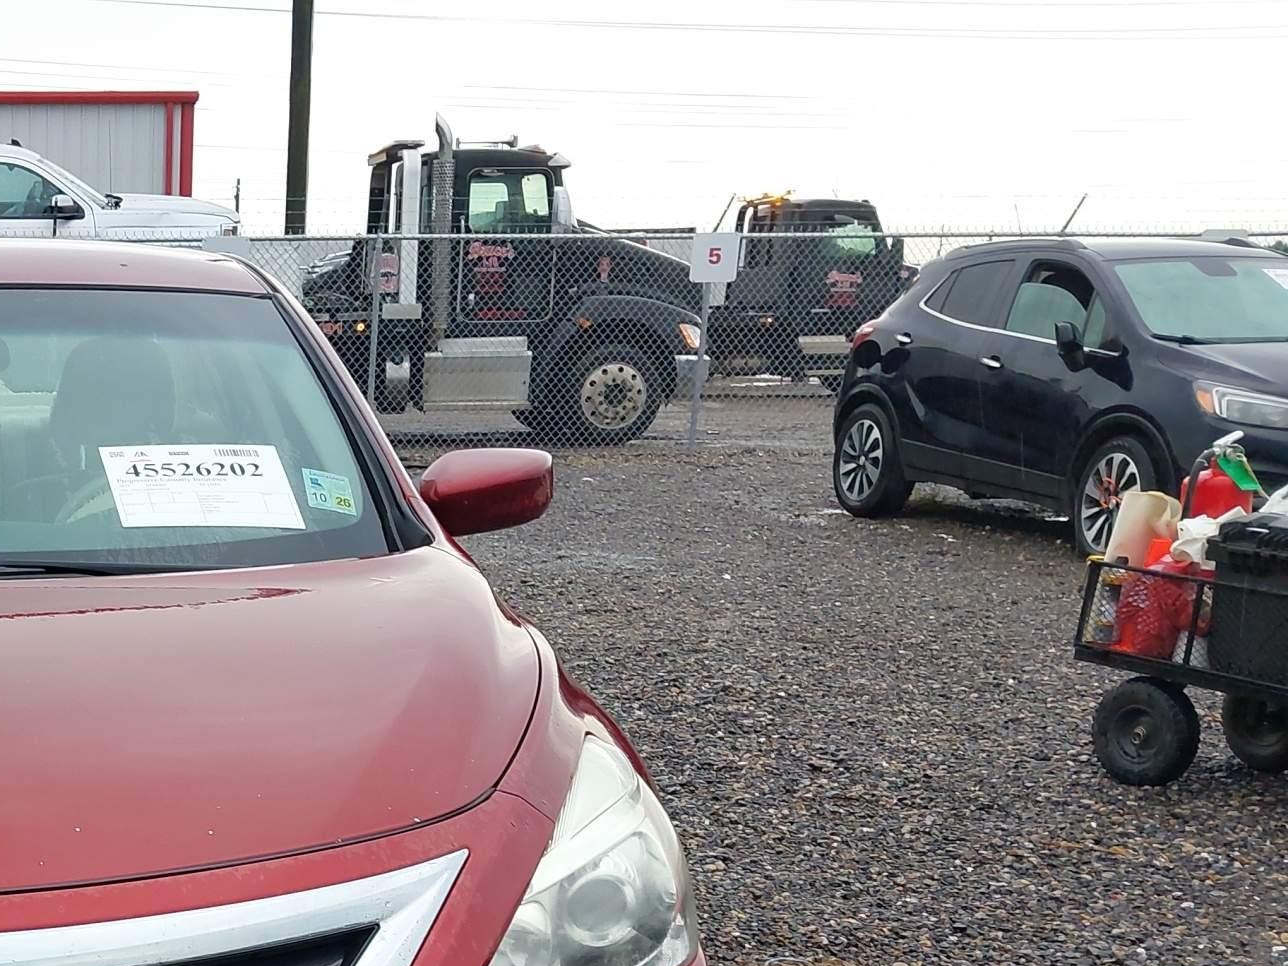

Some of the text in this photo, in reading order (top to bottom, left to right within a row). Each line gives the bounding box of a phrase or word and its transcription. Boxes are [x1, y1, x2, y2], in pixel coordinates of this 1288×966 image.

[708, 247, 722, 265] 5
[125, 462, 264, 478] 45526202
[311, 492, 328, 503] 10
[335, 496, 352, 508] 26
